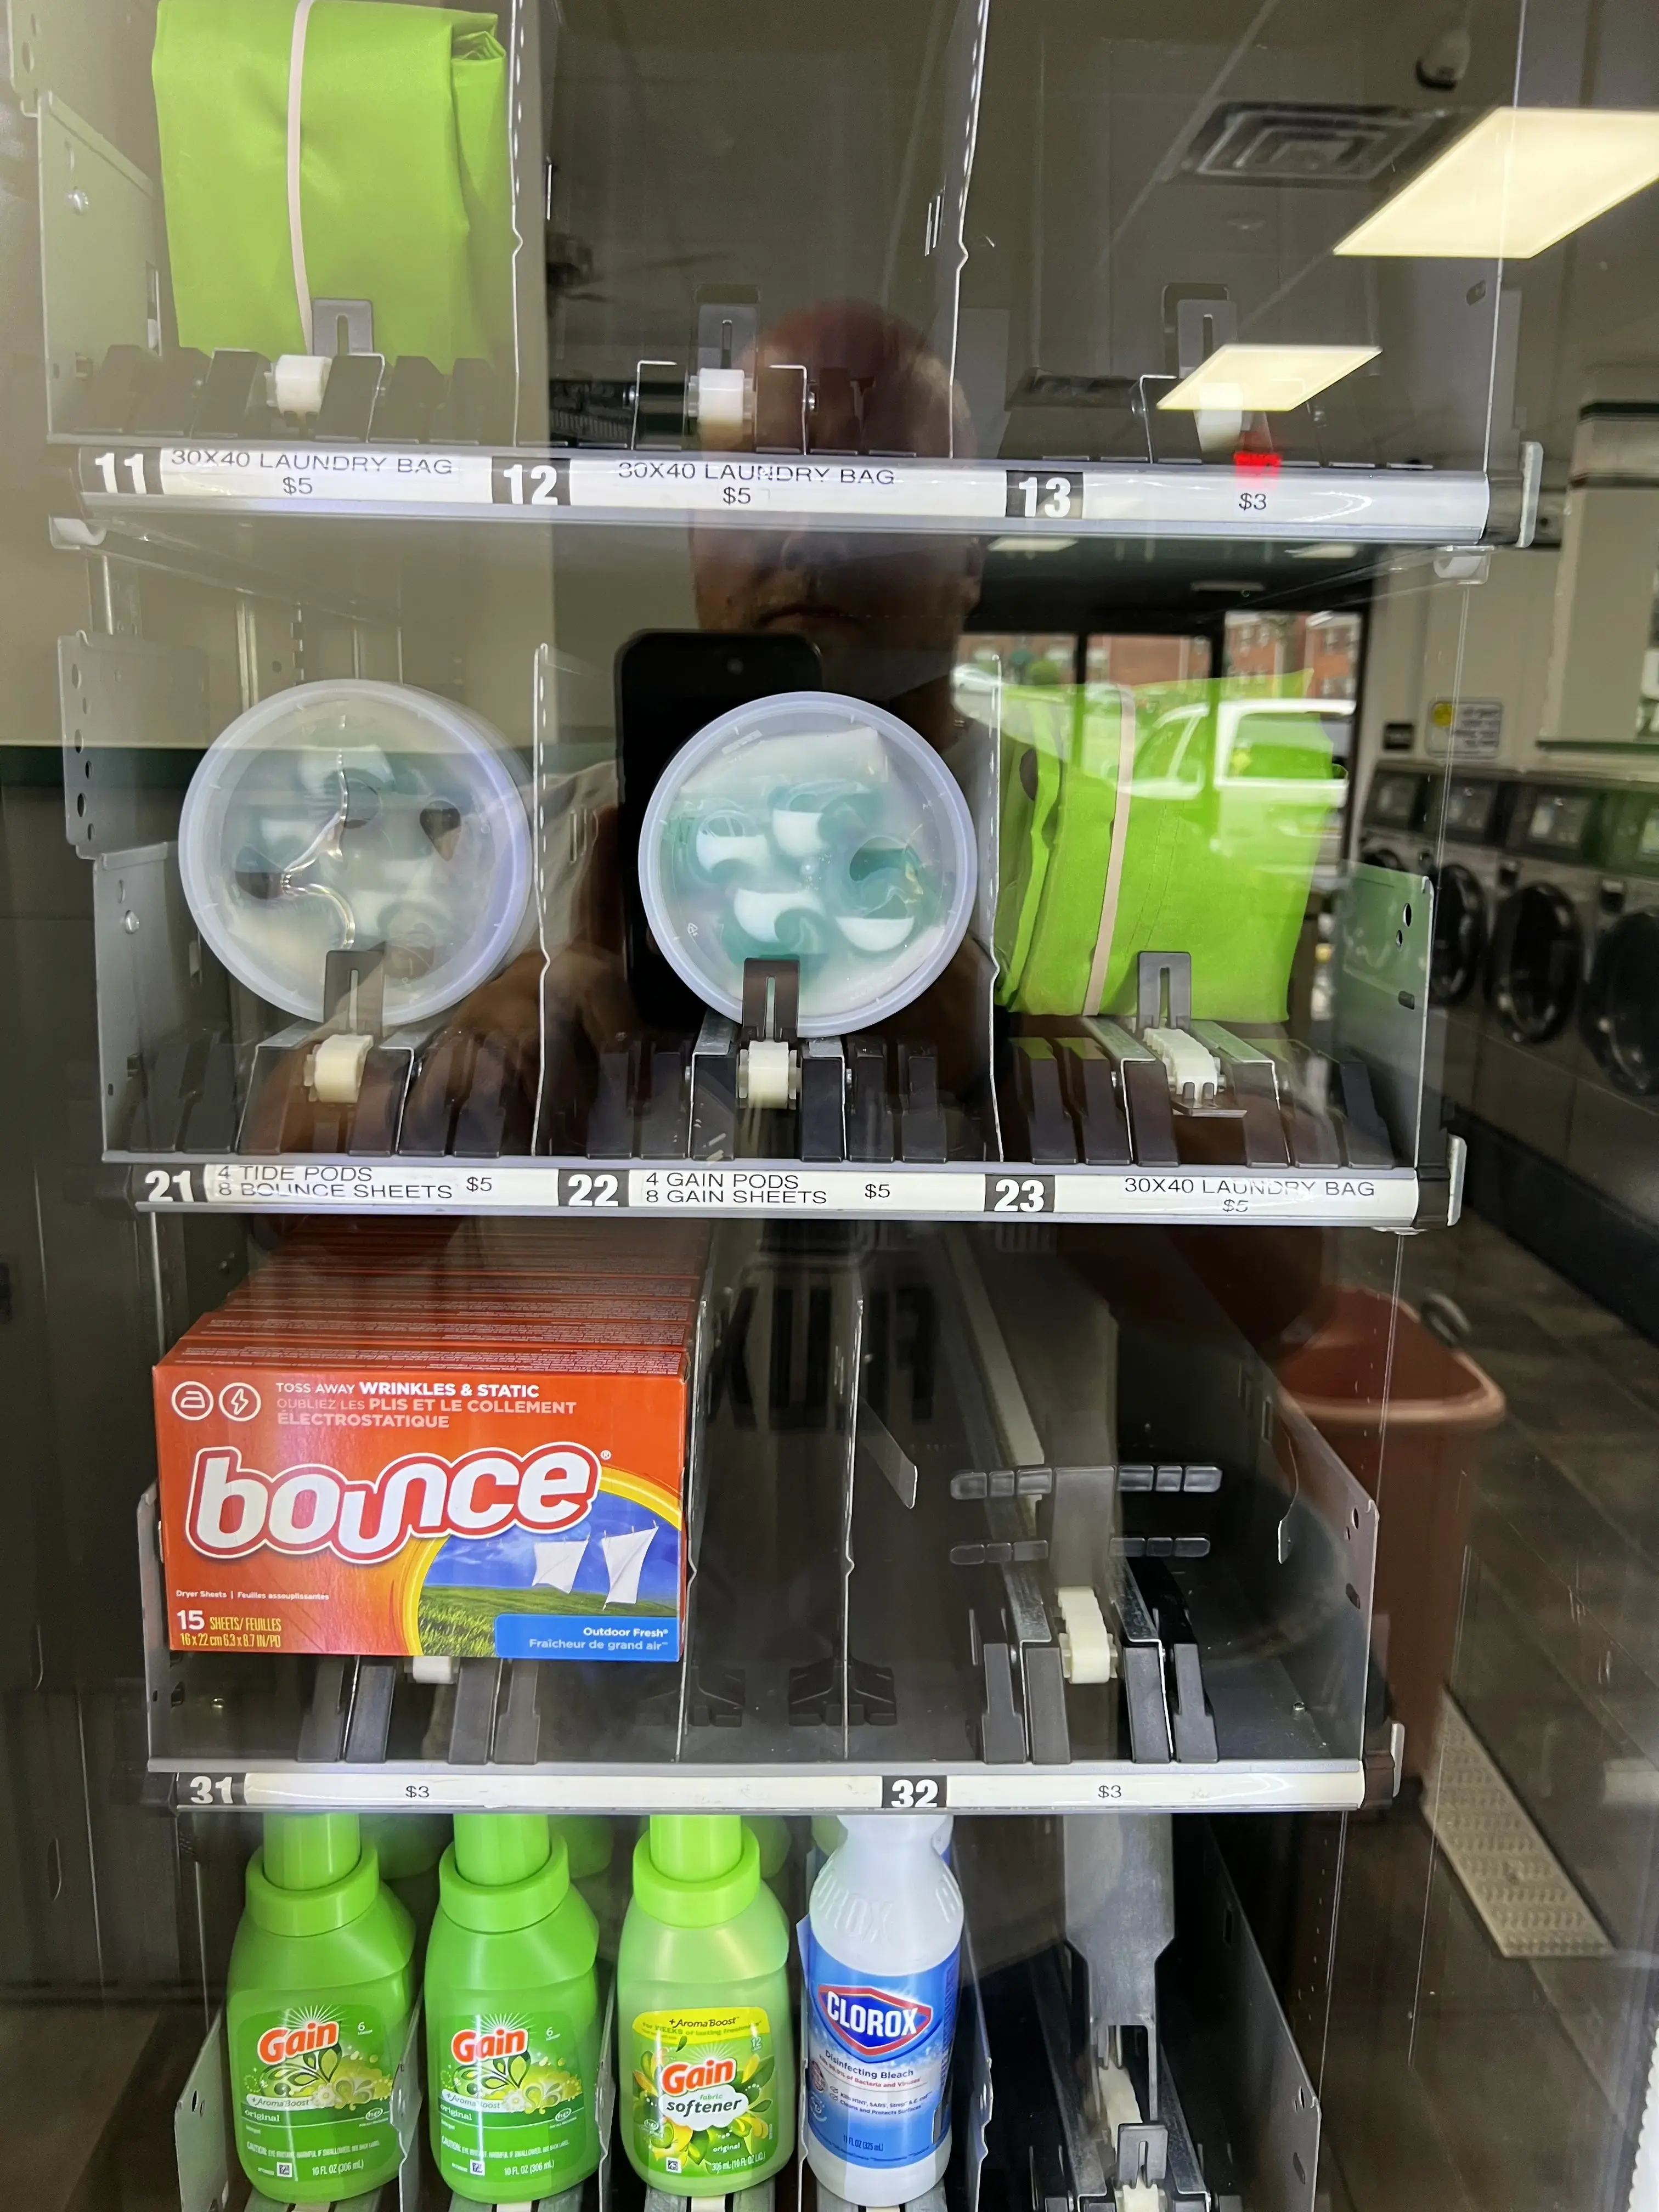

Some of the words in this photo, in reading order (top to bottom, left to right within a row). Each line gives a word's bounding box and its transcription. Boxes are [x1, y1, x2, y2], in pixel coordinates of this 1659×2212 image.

[172, 450, 249, 468] 30X40
[260, 453, 386, 472] LAUNDRY
[398, 458, 453, 475] BAG
[95, 453, 146, 494] 11
[619, 462, 696, 479] 30X40
[706, 464, 830, 483] LAUNDRY
[840, 469, 895, 486] BAG
[283, 477, 313, 495] $5
[503, 464, 558, 505] 12
[723, 487, 751, 505] $5
[1019, 476, 1071, 518] 13
[1238, 492, 1267, 511] $3
[219, 1166, 231, 1180] 4
[240, 1166, 295, 1181] TIDE
[304, 1166, 373, 1182] PODS
[646, 1172, 658, 1187] 4
[667, 1173, 724, 1188] GAIN
[733, 1174, 799, 1189] PODS
[145, 1170, 195, 1203] 21
[219, 1183, 231, 1197] 8
[241, 1183, 346, 1198] BOUNCE
[354, 1184, 453, 1199] SHEETS
[466, 1176, 492, 1193] $5
[567, 1173, 619, 1206] 22
[865, 1183, 891, 1199] $5
[1125, 1177, 1194, 1194] 30X40
[1203, 1177, 1316, 1195] LAUNDRY
[1325, 1181, 1375, 1197] BAG
[646, 1189, 658, 1203] 8
[667, 1189, 724, 1203] GAIN
[732, 1190, 827, 1204] SHEETS
[994, 1178, 1045, 1213] 23
[1222, 1199, 1249, 1214] $5
[275, 1382, 311, 1394] TOSS
[315, 1383, 356, 1395] AWAY
[359, 1381, 455, 1397] WRINKLES
[461, 1384, 473, 1397] &
[477, 1384, 539, 1398] STATIC
[277, 1398, 337, 1409] OUBLIEZ
[341, 1400, 365, 1410] LES
[369, 1398, 408, 1412] PLIS
[413, 1400, 433, 1412] ET
[441, 1400, 462, 1412] LE
[467, 1400, 577, 1414] COLLEMENT
[277, 1410, 449, 1429] ÉLECTROSTATIQUE
[192, 1446, 595, 1559] bounce
[176, 1590, 198, 1598] Dryer
[238, 1591, 266, 1599] Feuilles
[268, 1592, 329, 1601] assouplissantes
[177, 1610, 205, 1630] 15
[210, 1616, 243, 1631] SHEETS/
[246, 1618, 281, 1632] FEUILLES
[180, 1633, 191, 1646] 16
[192, 1636, 197, 1646] x
[198, 1633, 208, 1646] 22
[210, 1637, 222, 1646] cm
[236, 1637, 242, 1646] x
[243, 1634, 255, 1647] 8.7
[583, 1627, 630, 1637] Outdoor
[529, 1639, 586, 1649] Fraîcheur
[589, 1640, 604, 1649] de
[607, 1641, 642, 1651] grand
[190, 1776, 234, 1805] 31
[406, 1785, 430, 1799] $3
[891, 1779, 939, 1808] 32
[1098, 1785, 1122, 1799] $3
[826, 1990, 919, 2038] CLOROX
[358, 2022, 366, 2031] 6
[546, 2027, 554, 2036] 6
[258, 2021, 340, 2064] Gain
[452, 2027, 528, 2064] Gain
[752, 2036, 761, 2048] 12
[825, 2049, 878, 2080] Disinfecting
[881, 2069, 913, 2079] Bleach
[662, 2058, 736, 2095] Gain
[855, 2078, 882, 2087] Bacteria
[700, 2092, 723, 2101] fabric
[245, 2109, 280, 2122] original
[440, 2104, 472, 2121] original
[666, 2099, 742, 2118] softener
[713, 2142, 741, 2153] original
[843, 2135, 848, 2143] 11
[855, 2139, 862, 2148] OZ
[862, 2141, 873, 2151] (325
[312, 2167, 319, 2176] 10
[329, 2164, 337, 2174] OZ
[504, 2167, 511, 2176] 10
[521, 2164, 529, 2174] OZ
[530, 2163, 543, 2175] (306
